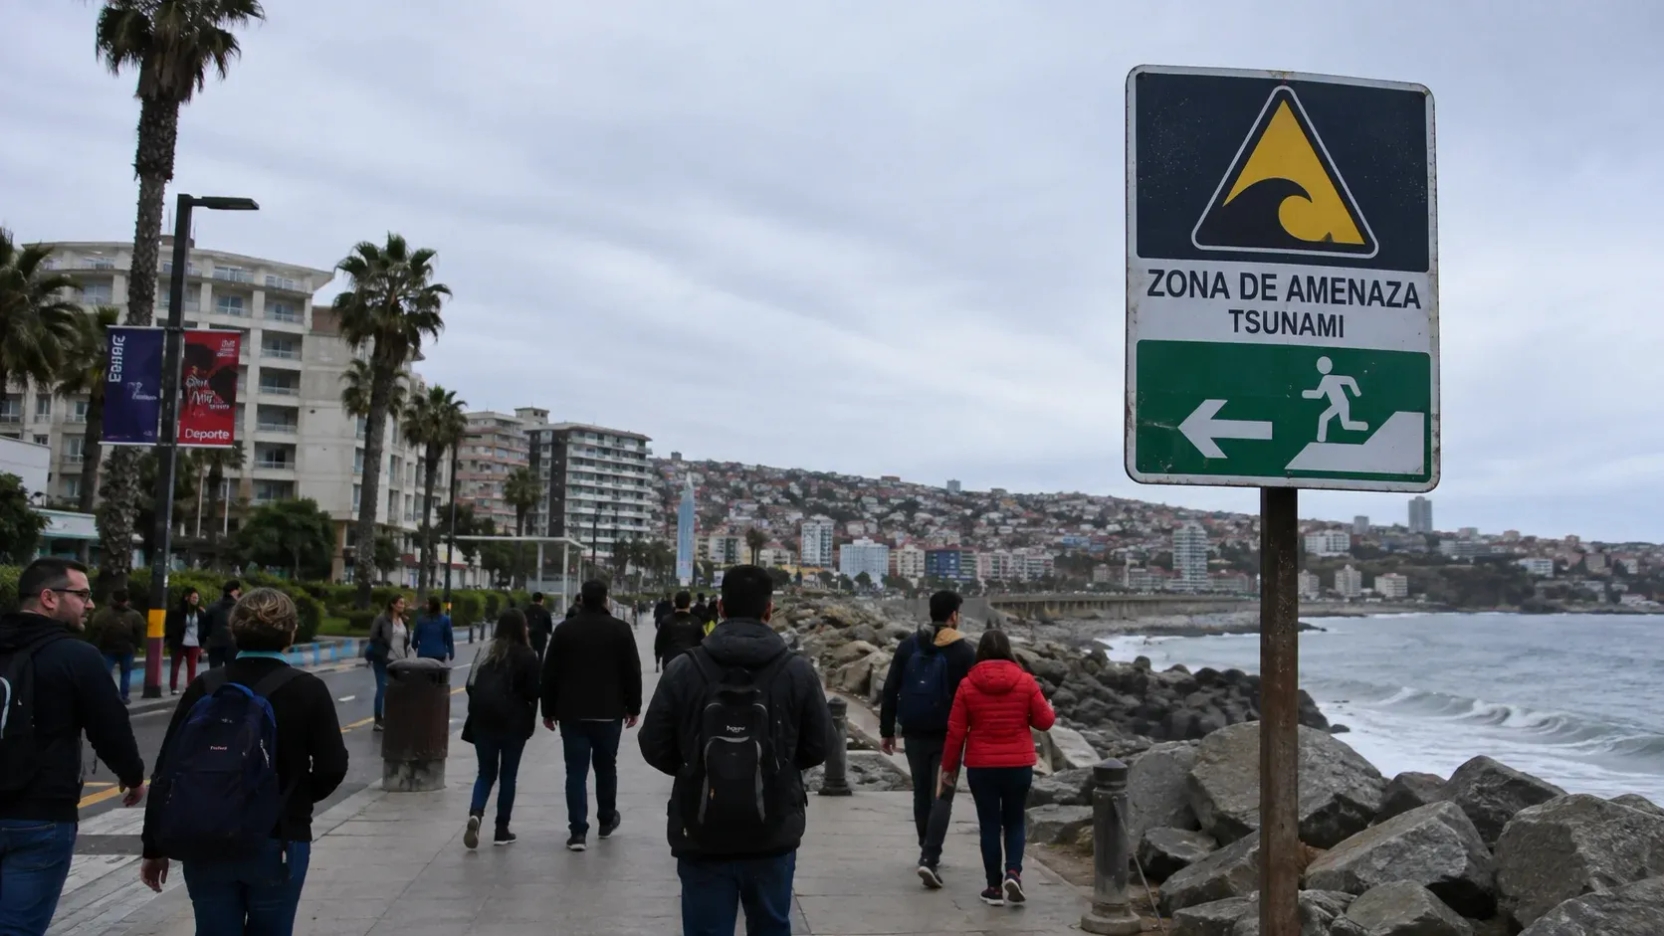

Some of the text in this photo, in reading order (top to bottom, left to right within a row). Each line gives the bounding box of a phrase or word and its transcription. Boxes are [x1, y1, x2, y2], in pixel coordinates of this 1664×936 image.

[1147, 269, 1421, 309] ZONA DE AMENAZA
[1228, 309, 1344, 338] TSUNAMI
[185, 428, 230, 441] Deporte
